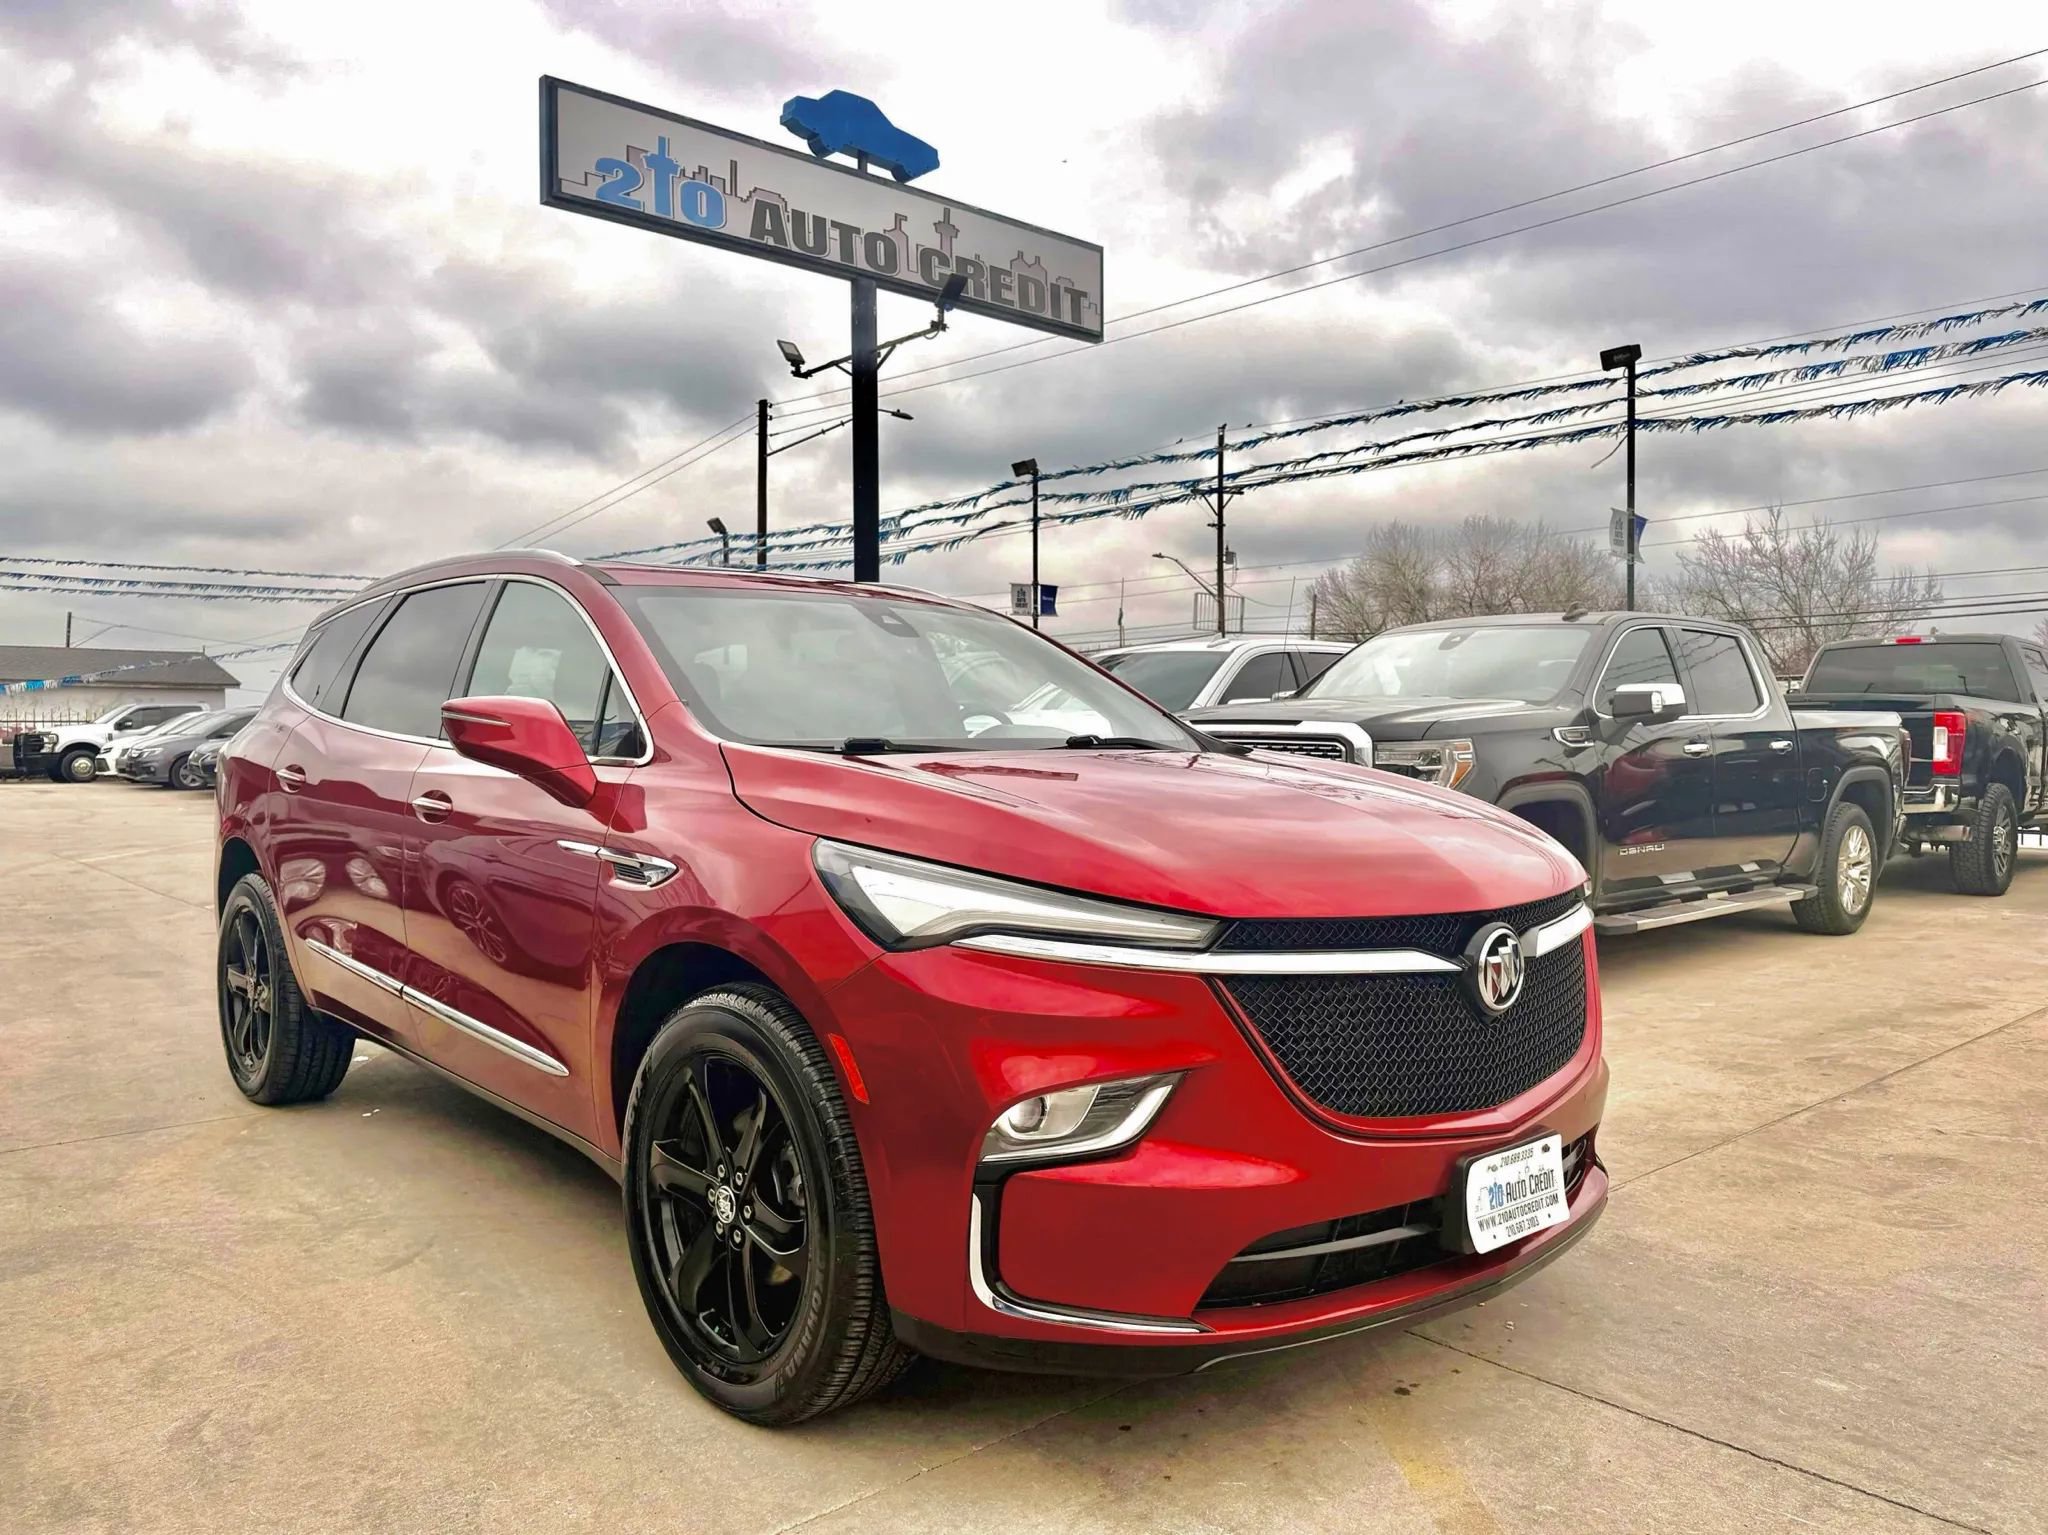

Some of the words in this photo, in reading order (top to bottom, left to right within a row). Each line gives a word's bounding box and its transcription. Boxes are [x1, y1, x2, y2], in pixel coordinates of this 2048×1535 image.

[594, 136, 728, 230] 210
[748, 199, 901, 277] AUTO
[918, 246, 1089, 326] CREDIT
[1619, 843, 1665, 856] DENALI
[1488, 1181, 1505, 1210] 210
[1506, 1179, 1527, 1204] AUTO
[1529, 1169, 1555, 1195] CREDIT
[1478, 1193, 1559, 1232] WWW.210AUTOCREDIT.COM
